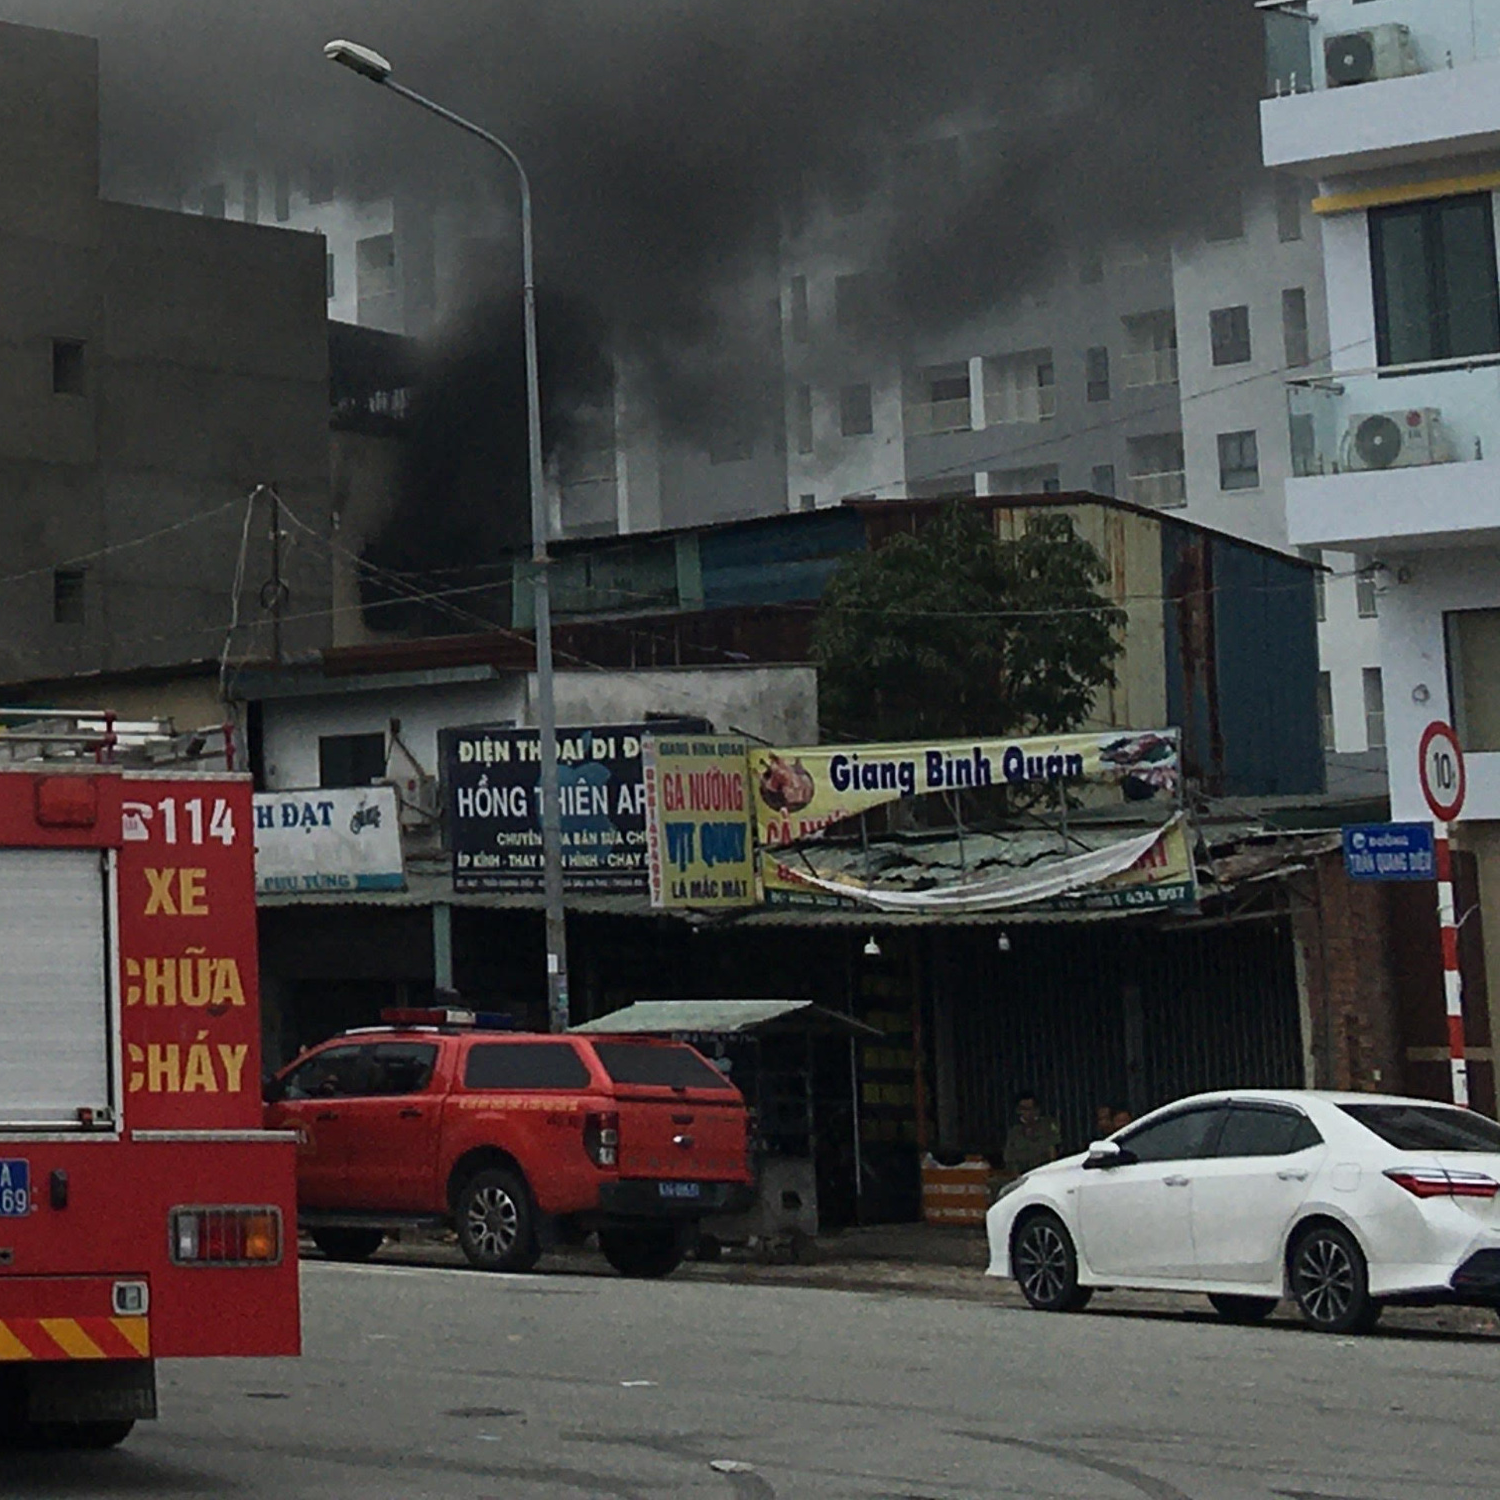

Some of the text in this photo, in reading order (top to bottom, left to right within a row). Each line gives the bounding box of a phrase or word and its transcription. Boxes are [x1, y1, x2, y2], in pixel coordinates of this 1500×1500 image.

[458, 736, 510, 768] ĐIỆN
[516, 737, 585, 766] THẠI
[592, 736, 616, 759] DI
[830, 753, 915, 797] Giang
[925, 747, 991, 787] Bình
[663, 764, 685, 812] GÀ
[157, 797, 236, 845] 114
[281, 801, 335, 834] ĐẠT
[143, 868, 209, 916] XE
